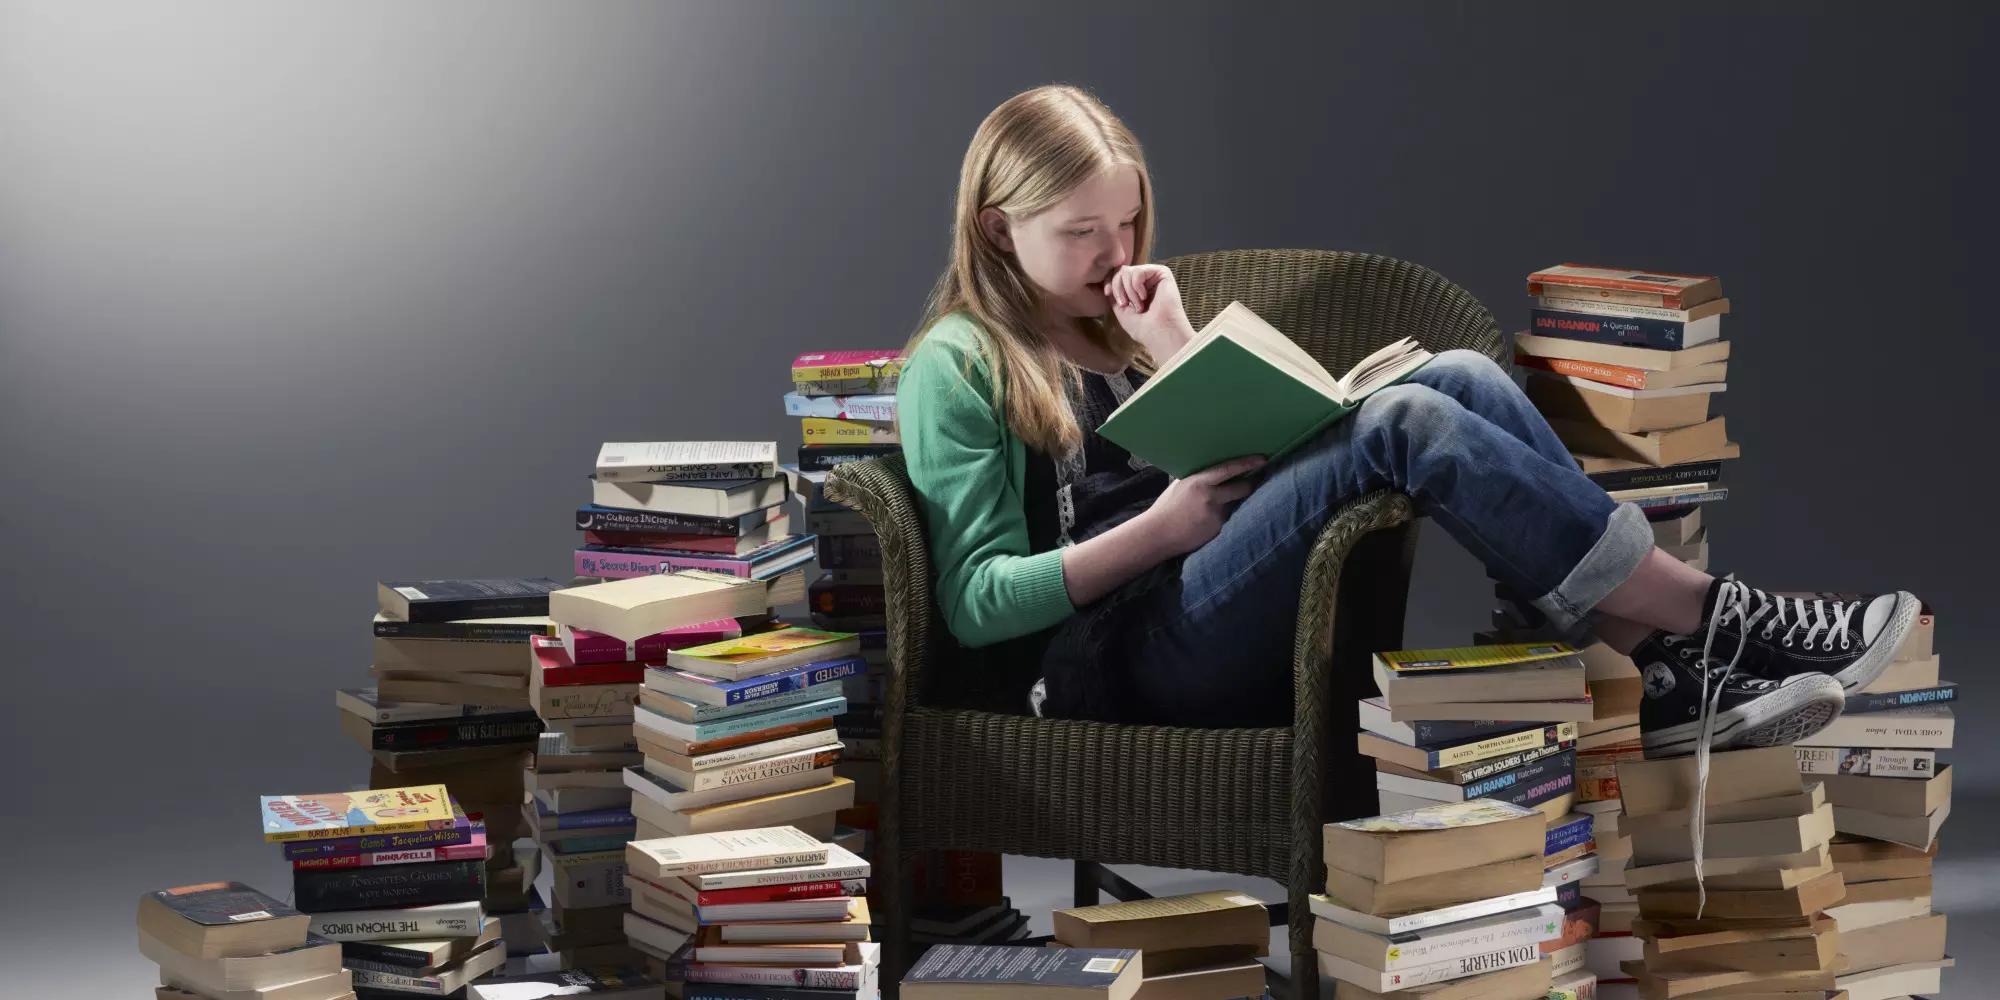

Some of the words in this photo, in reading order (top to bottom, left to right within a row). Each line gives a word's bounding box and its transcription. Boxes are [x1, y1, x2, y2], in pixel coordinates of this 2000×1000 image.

[1536, 318, 1557, 328] IAN
[1558, 320, 1600, 332] RANKIN
[1609, 322, 1639, 331] Question
[647, 464, 717, 473] COMPLICITY
[711, 471, 732, 479] IAIN
[666, 472, 707, 480] BANKS
[607, 513, 639, 524] CURIOUS
[640, 513, 679, 526] INCIDENT
[815, 663, 856, 685] TWISTED
[743, 681, 778, 695] ANDERSON
[1936, 688, 1953, 699] IAN
[1899, 691, 1936, 704] RANKIN
[1879, 755, 1907, 764] Through
[760, 761, 812, 779] LINDSEY
[1461, 770, 1474, 783] THE
[1473, 765, 1494, 778] VIRGIN
[1494, 757, 1521, 772] SOLDIERS
[1523, 752, 1539, 762] Leslie
[720, 771, 757, 786] DAVIS
[1467, 786, 1482, 798] IAN
[1483, 774, 1516, 794] RANKIN
[1517, 766, 1544, 779] Watchman
[1557, 774, 1572, 788] IAN
[1528, 779, 1557, 798] RANKIN
[307, 828, 330, 838] BURIED
[333, 827, 350, 837] ALIVE
[392, 834, 433, 847] Jacqueline
[434, 831, 460, 841] Wilson
[332, 856, 357, 865] SWIFT
[774, 855, 794, 864] AMIS
[795, 852, 826, 863] MARTIN
[789, 884, 808, 892] DIARY
[322, 923, 353, 936] BIRDS
[356, 922, 397, 933] THORN
[398, 920, 420, 932] THE
[1508, 946, 1536, 963] TOM
[1460, 951, 1506, 973] SHARPE
